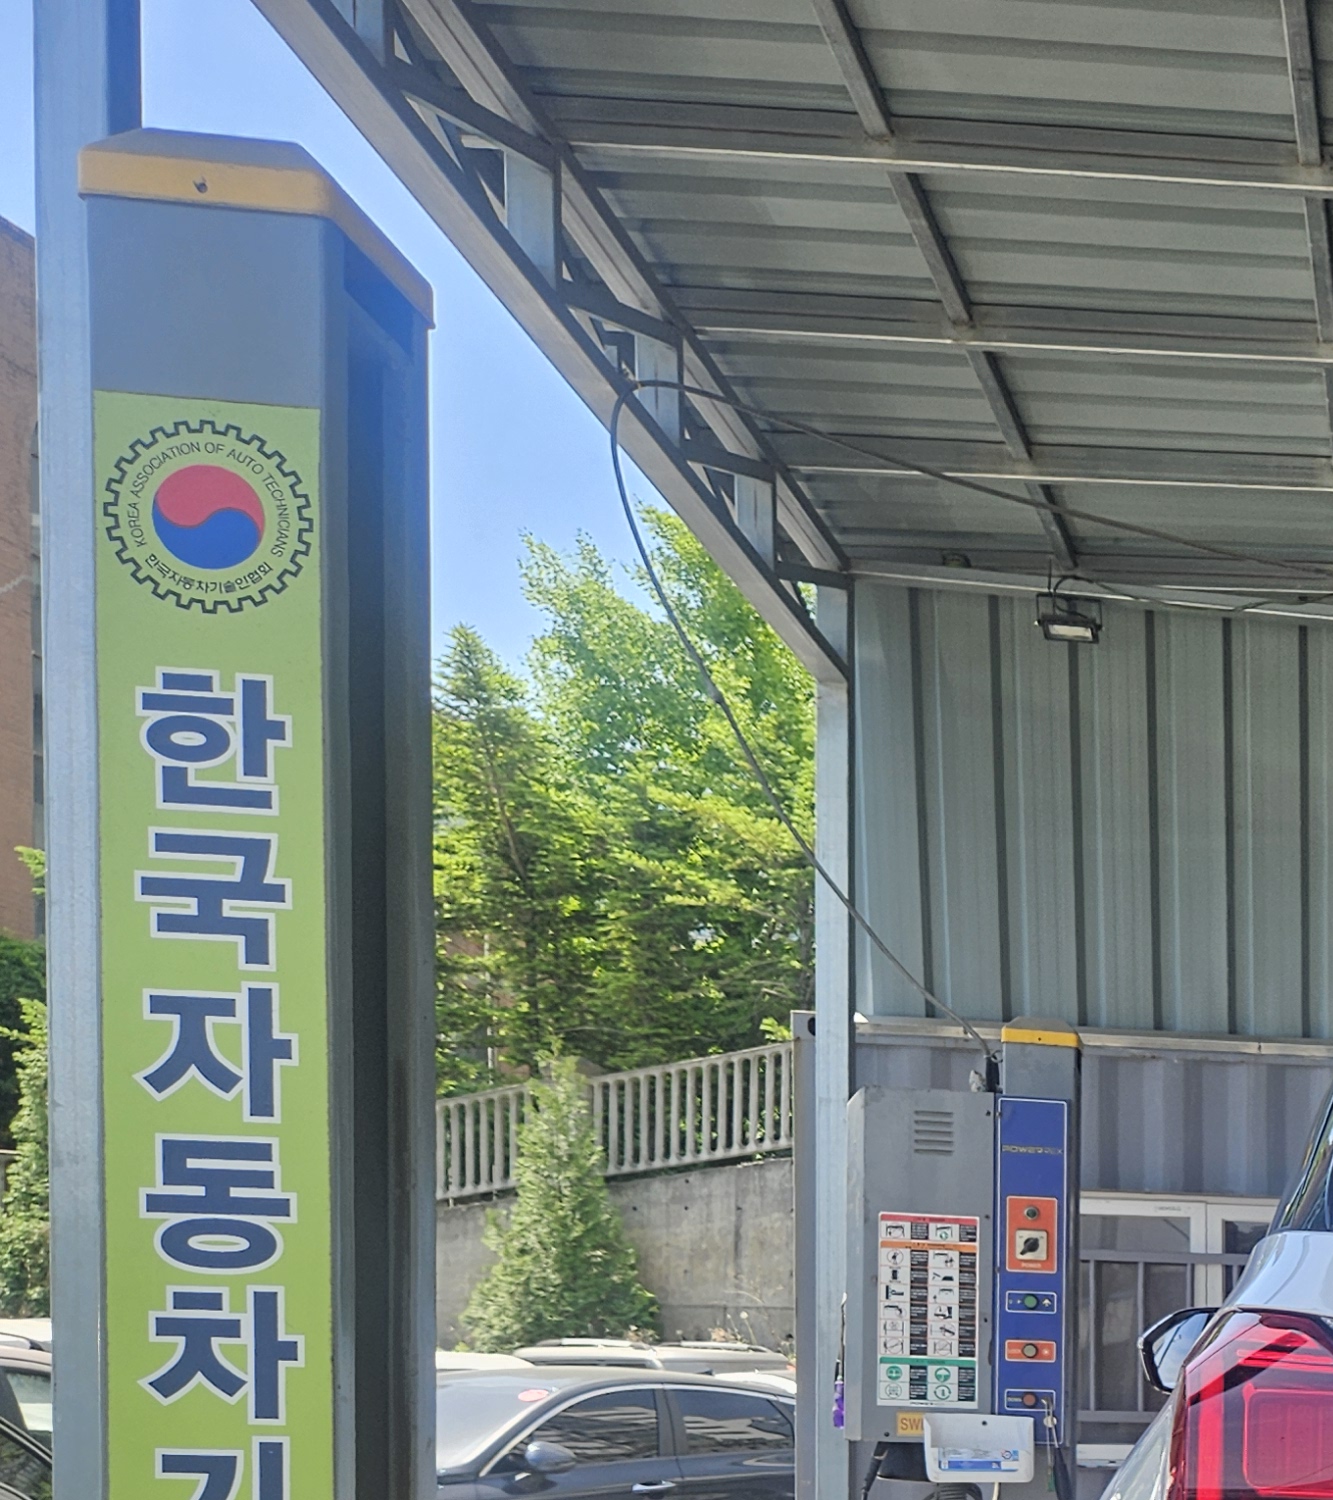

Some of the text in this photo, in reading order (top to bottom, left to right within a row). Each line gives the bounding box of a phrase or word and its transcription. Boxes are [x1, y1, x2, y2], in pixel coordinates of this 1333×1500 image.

[128, 441, 290, 557] KOREA ASSOCIATION OF AUTO TECHNICIANS
[145, 553, 274, 594] 한국자동차기술인협회
